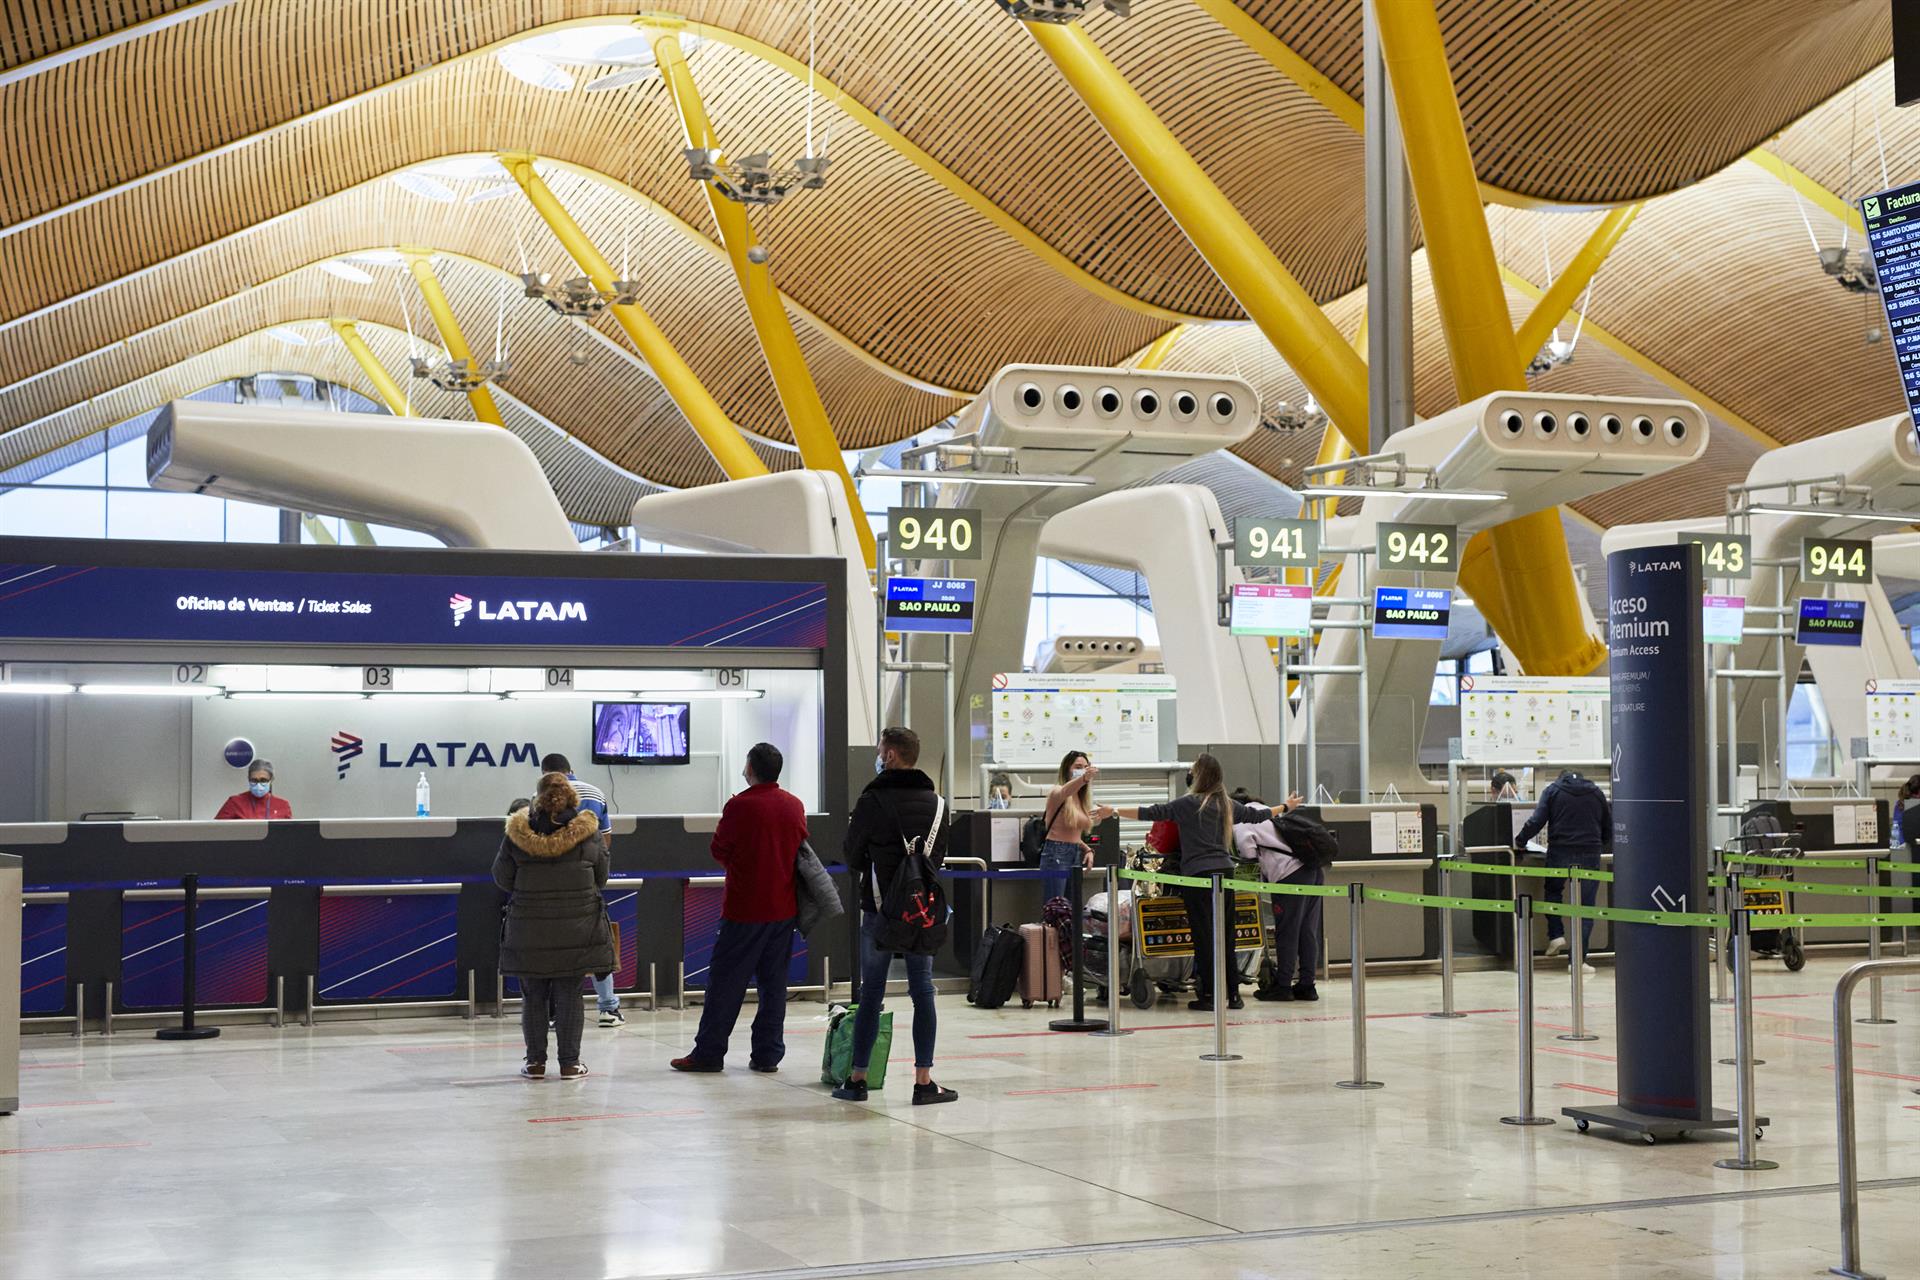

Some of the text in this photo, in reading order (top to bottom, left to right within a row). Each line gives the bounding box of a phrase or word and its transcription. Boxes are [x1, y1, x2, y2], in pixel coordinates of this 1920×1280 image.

[1882, 227, 1901, 238] SANTO
[1887, 245, 1904, 255] DAKAR
[899, 517, 972, 551] 940
[1249, 527, 1306, 559] 941
[1388, 532, 1449, 564] 942
[1638, 561, 1682, 573] LATAM
[1810, 546, 1866, 577] 944
[932, 581, 943, 589] JJ
[176, 596, 372, 614] Oficina de Ventas / Ticket Sales
[479, 601, 588, 621] LATAM
[899, 602, 961, 612] SAO PAULO
[1386, 609, 1439, 620] SAO PAULO
[1809, 619, 1855, 628] SAO PAULO
[1629, 644, 1660, 656] Access
[177, 665, 204, 683] 02
[366, 668, 391, 686] 03
[548, 669, 572, 686] 04
[719, 670, 742, 686] 05
[379, 742, 541, 768] LATAM
